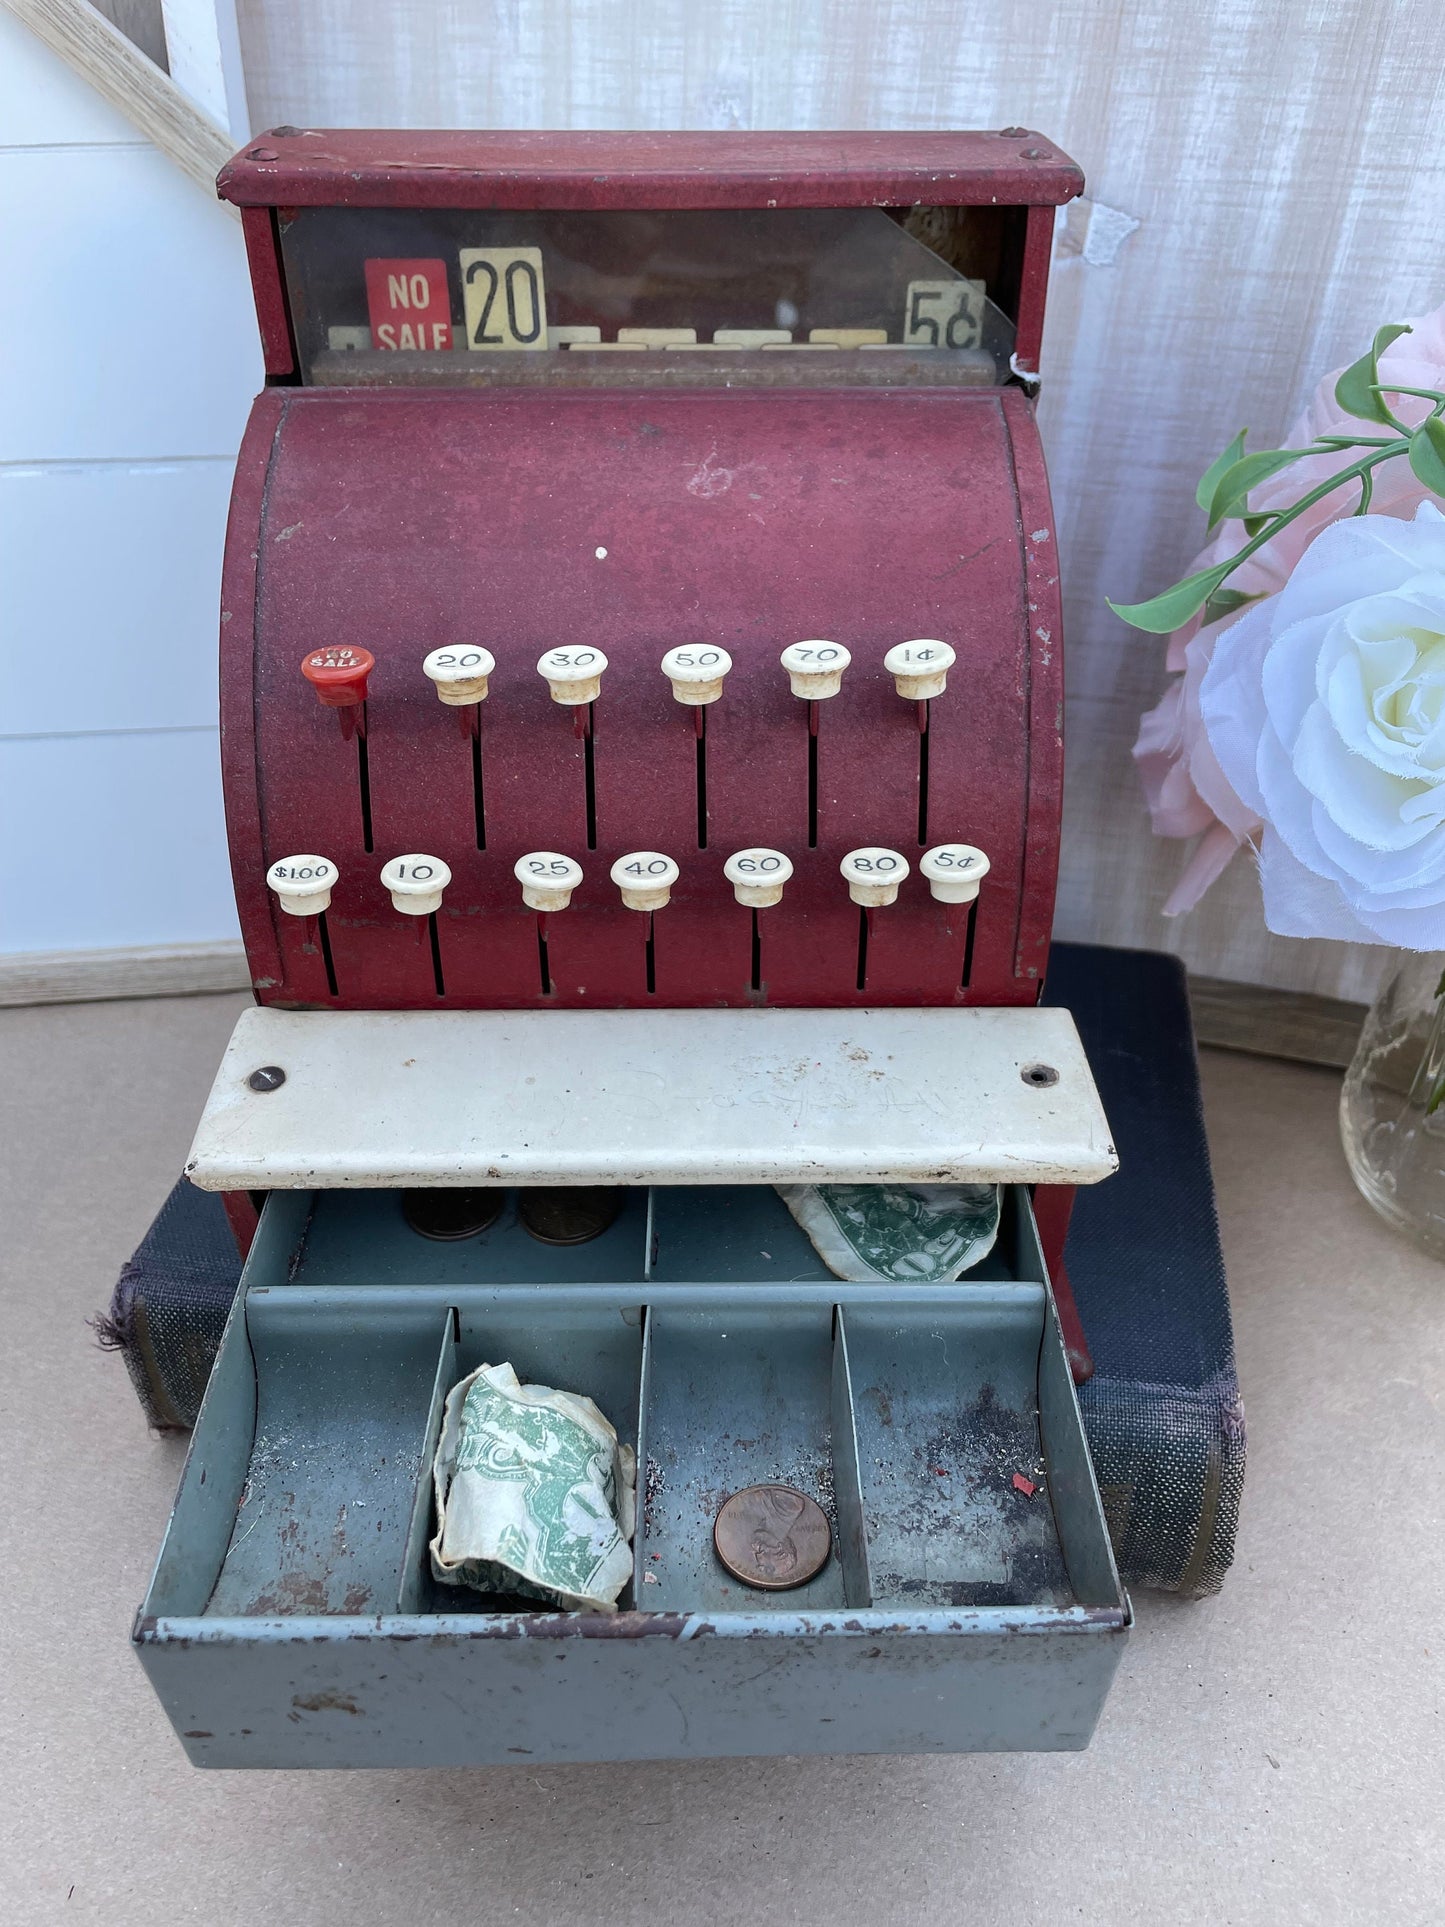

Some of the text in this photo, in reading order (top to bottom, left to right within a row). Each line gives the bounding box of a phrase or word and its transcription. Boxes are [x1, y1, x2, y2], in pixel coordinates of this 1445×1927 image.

[388, 274, 430, 310] NO
[466, 260, 541, 344] 20
[910, 291, 977, 349] 5¢
[377, 322, 448, 350] SALE
[310, 655, 359, 667] SALE
[437, 653, 482, 668] 20
[549, 652, 596, 667] 30
[675, 652, 720, 667] 50
[794, 648, 839, 662] 70
[904, 649, 935, 662] 1¢
[529, 860, 570, 876] 25
[624, 860, 668, 875] 40
[737, 856, 782, 872] 60
[853, 856, 898, 872] 80
[934, 852, 975, 869] 5¢
[398, 863, 434, 880] 10
